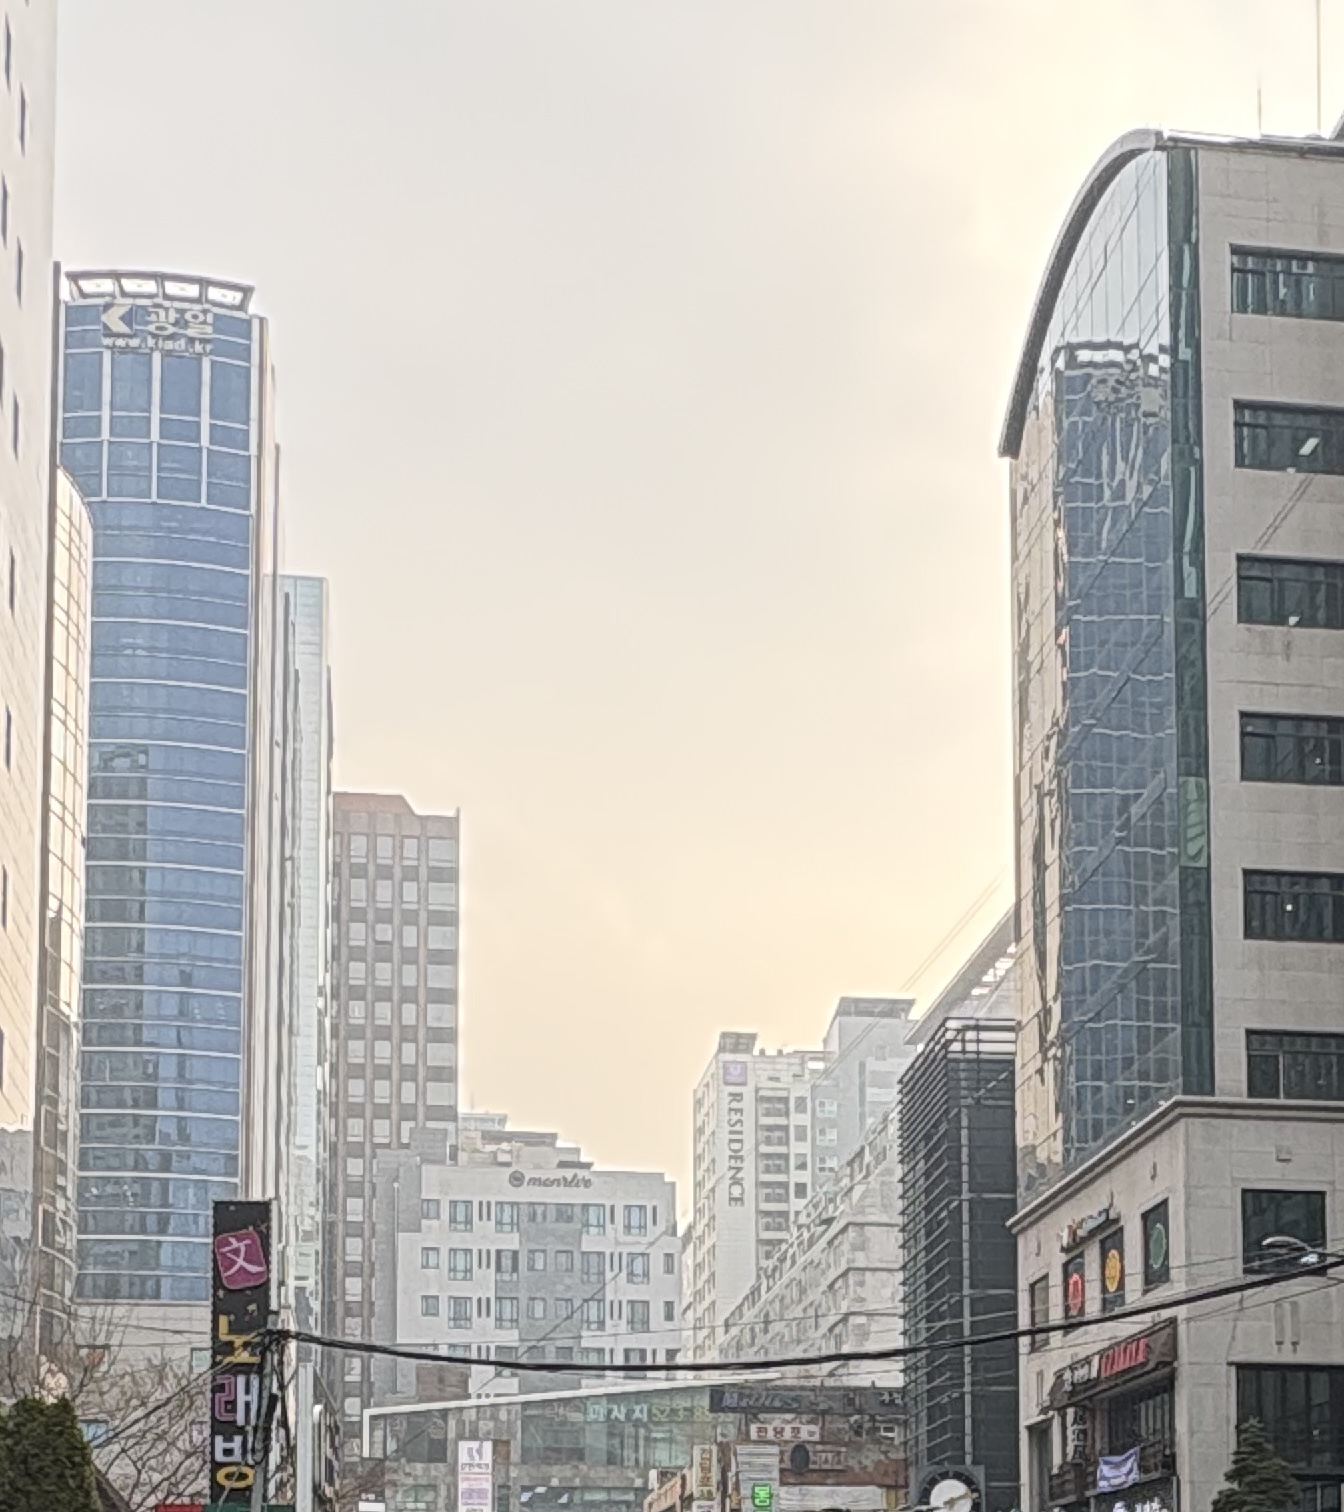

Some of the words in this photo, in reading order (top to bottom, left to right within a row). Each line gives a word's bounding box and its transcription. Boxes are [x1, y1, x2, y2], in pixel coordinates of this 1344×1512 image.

[219, 1237, 265, 1277] 文
[214, 1313, 261, 1489] 노래방
[588, 1403, 648, 1422] 마사지
